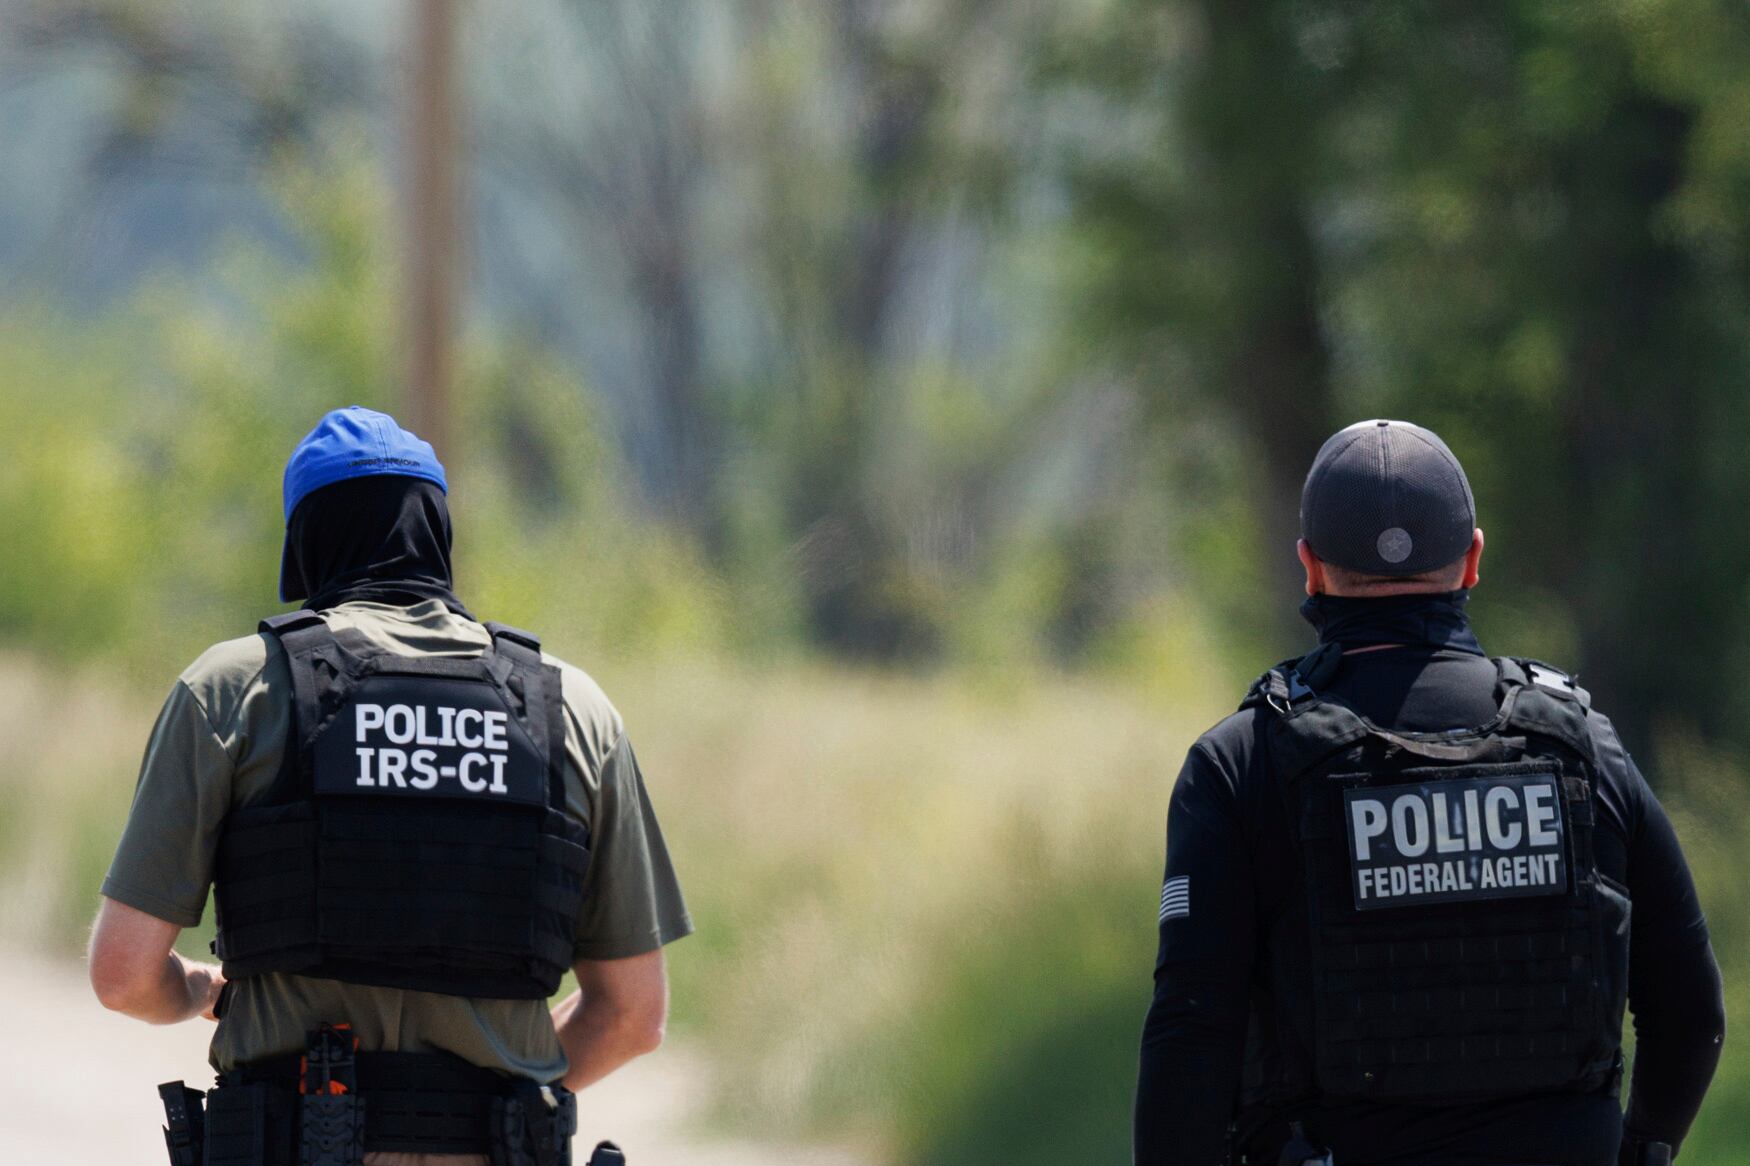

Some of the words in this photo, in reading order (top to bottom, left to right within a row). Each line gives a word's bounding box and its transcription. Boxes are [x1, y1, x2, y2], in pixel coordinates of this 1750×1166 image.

[355, 703, 508, 750] POLICE
[356, 747, 508, 793] IRS-CI
[1351, 784, 1558, 861] POLICE
[1357, 861, 1473, 899] FEDERAL
[1480, 853, 1559, 888] AGENT
